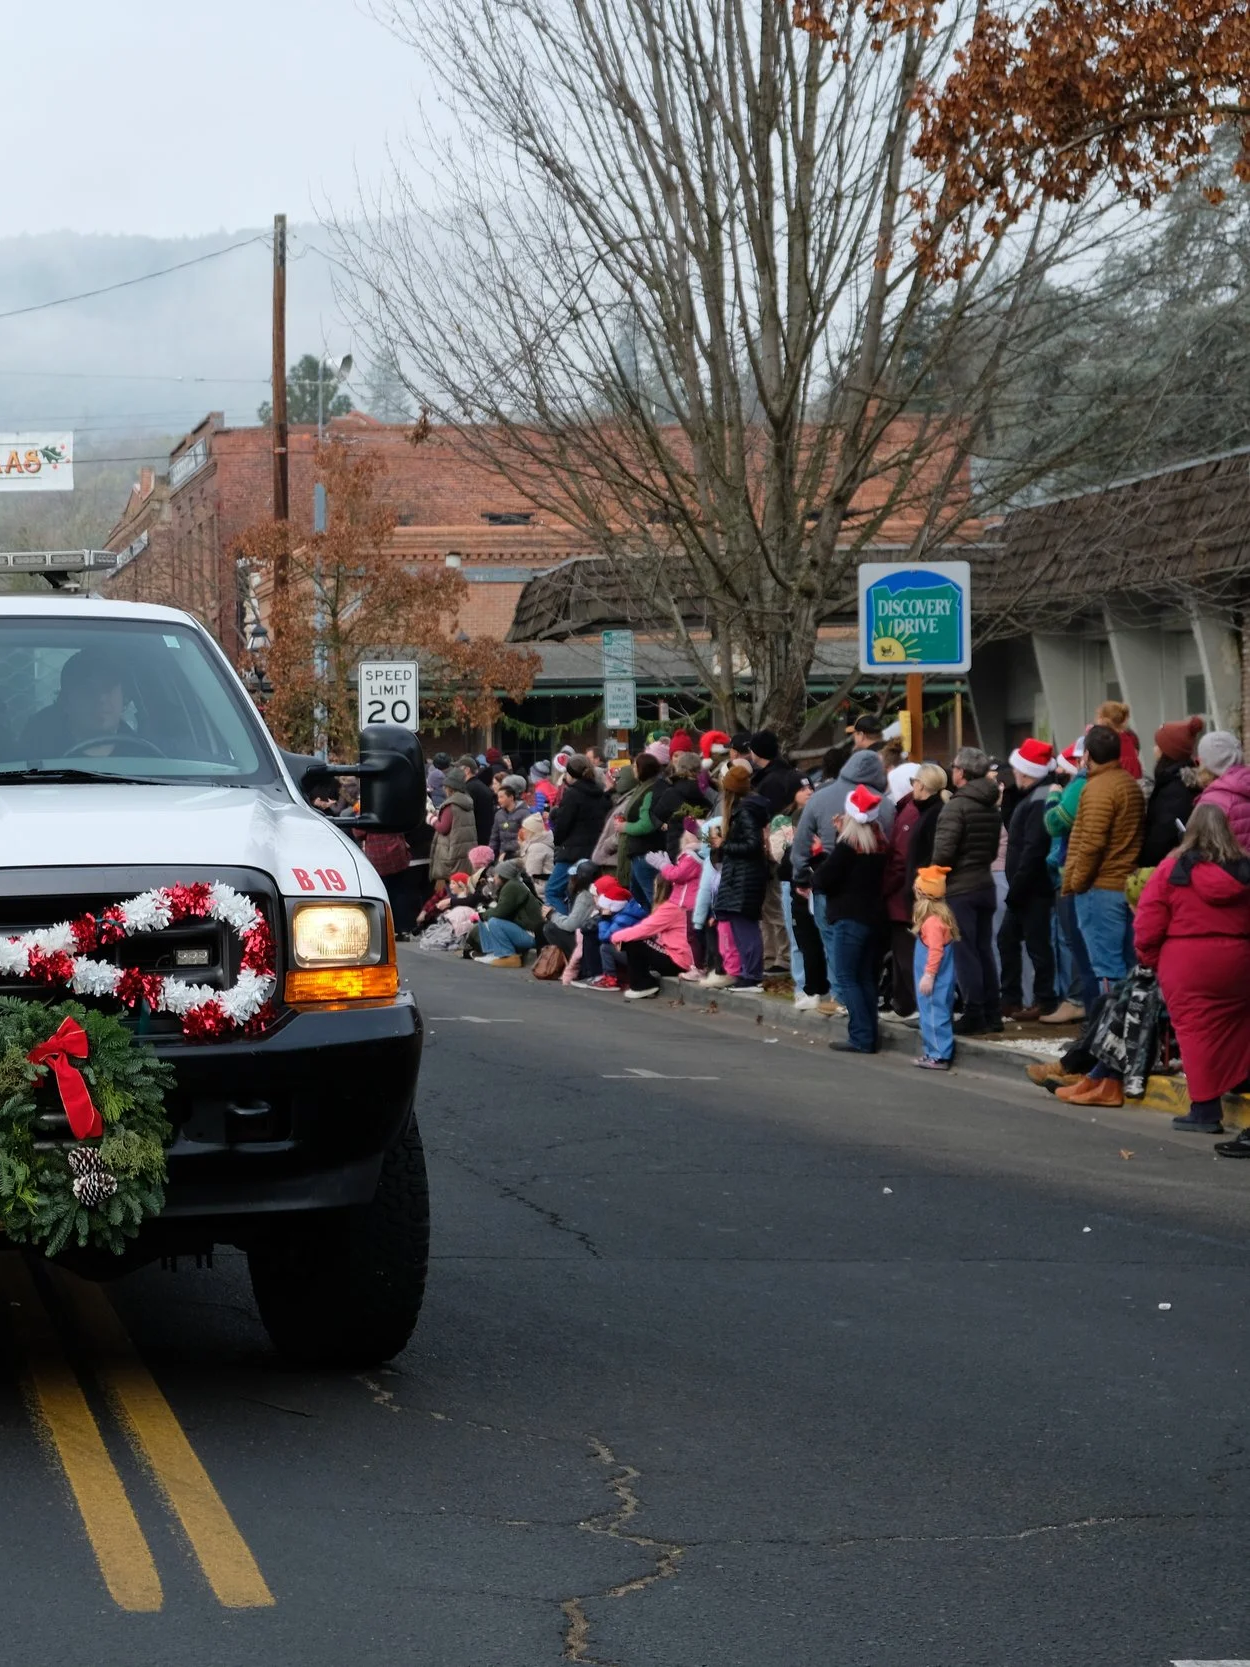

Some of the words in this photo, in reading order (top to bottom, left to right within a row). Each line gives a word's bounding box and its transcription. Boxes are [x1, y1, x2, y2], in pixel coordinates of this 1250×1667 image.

[877, 598, 953, 617] DISCOVERY
[893, 617, 939, 635] DRIVE
[365, 670, 413, 681] SPEED
[370, 684, 407, 696] LIMIT
[367, 699, 411, 724] 20
